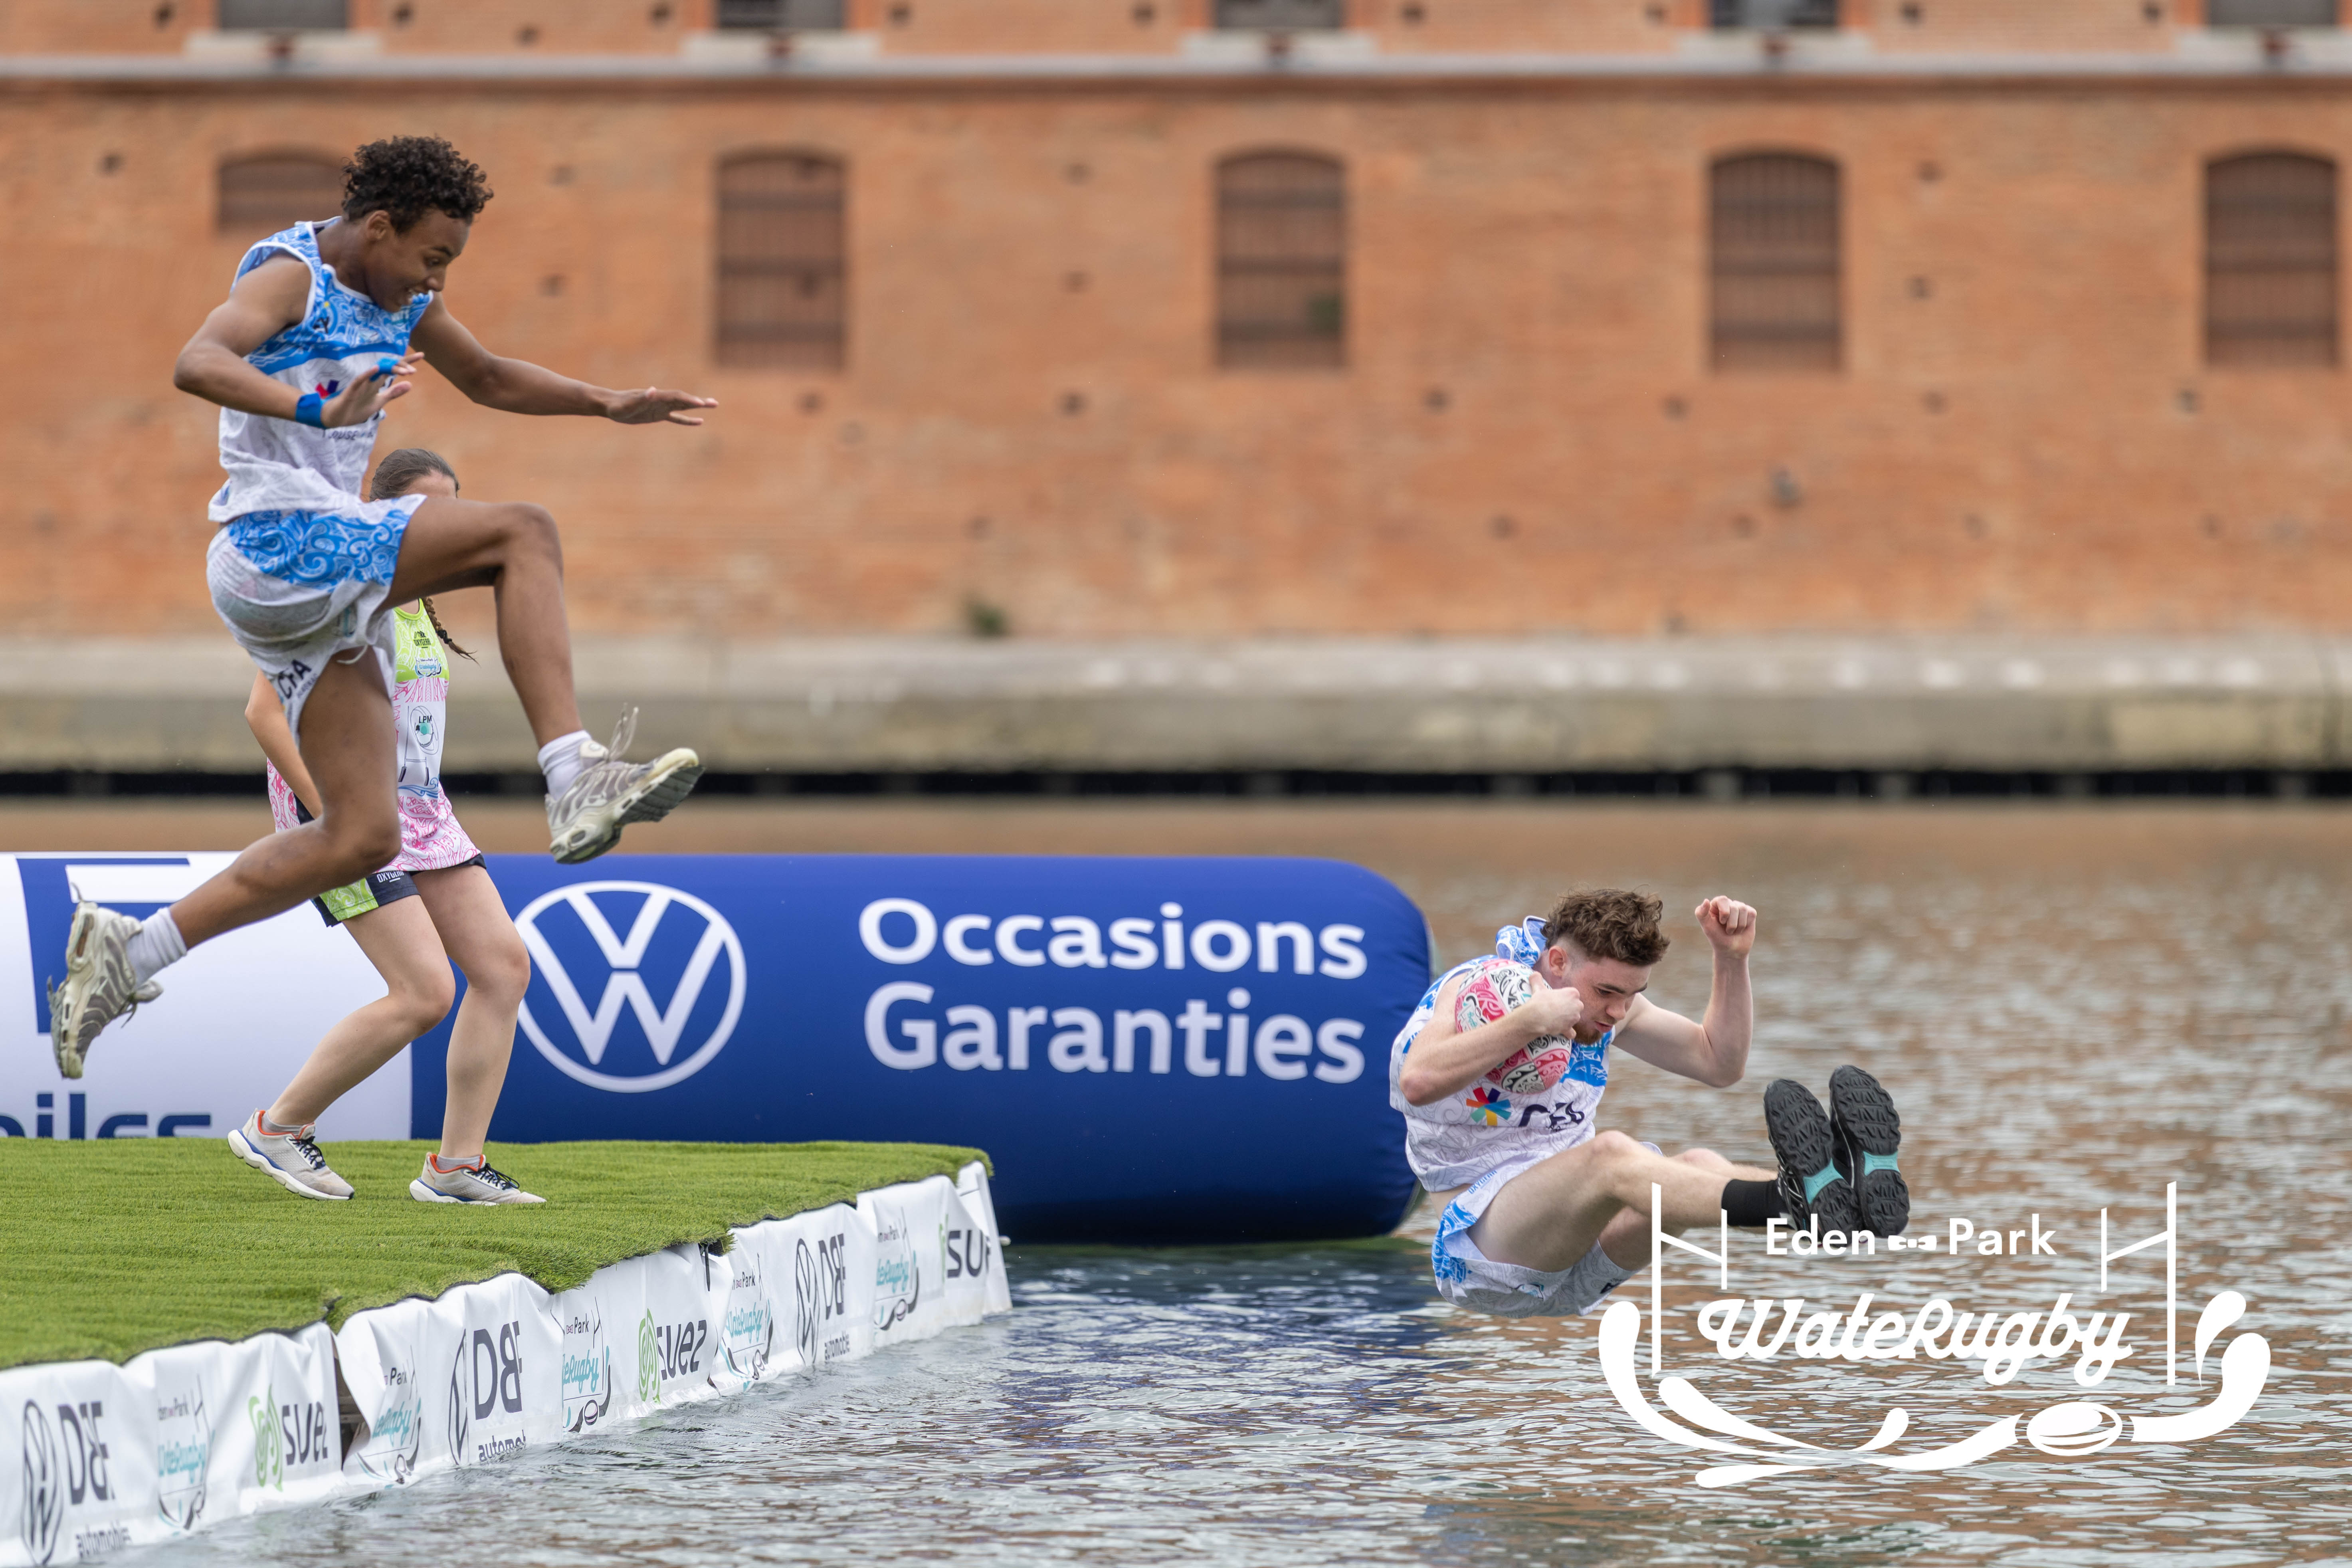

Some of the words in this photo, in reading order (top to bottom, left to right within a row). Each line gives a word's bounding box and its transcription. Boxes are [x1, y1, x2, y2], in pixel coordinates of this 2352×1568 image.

[859, 898, 1367, 980] Occasions
[865, 982, 1366, 1083] Garanties
[742, 1271, 756, 1288] Park
[574, 1313, 590, 1334] Park
[656, 1319, 707, 1381] suez
[390, 1367, 407, 1386] Park
